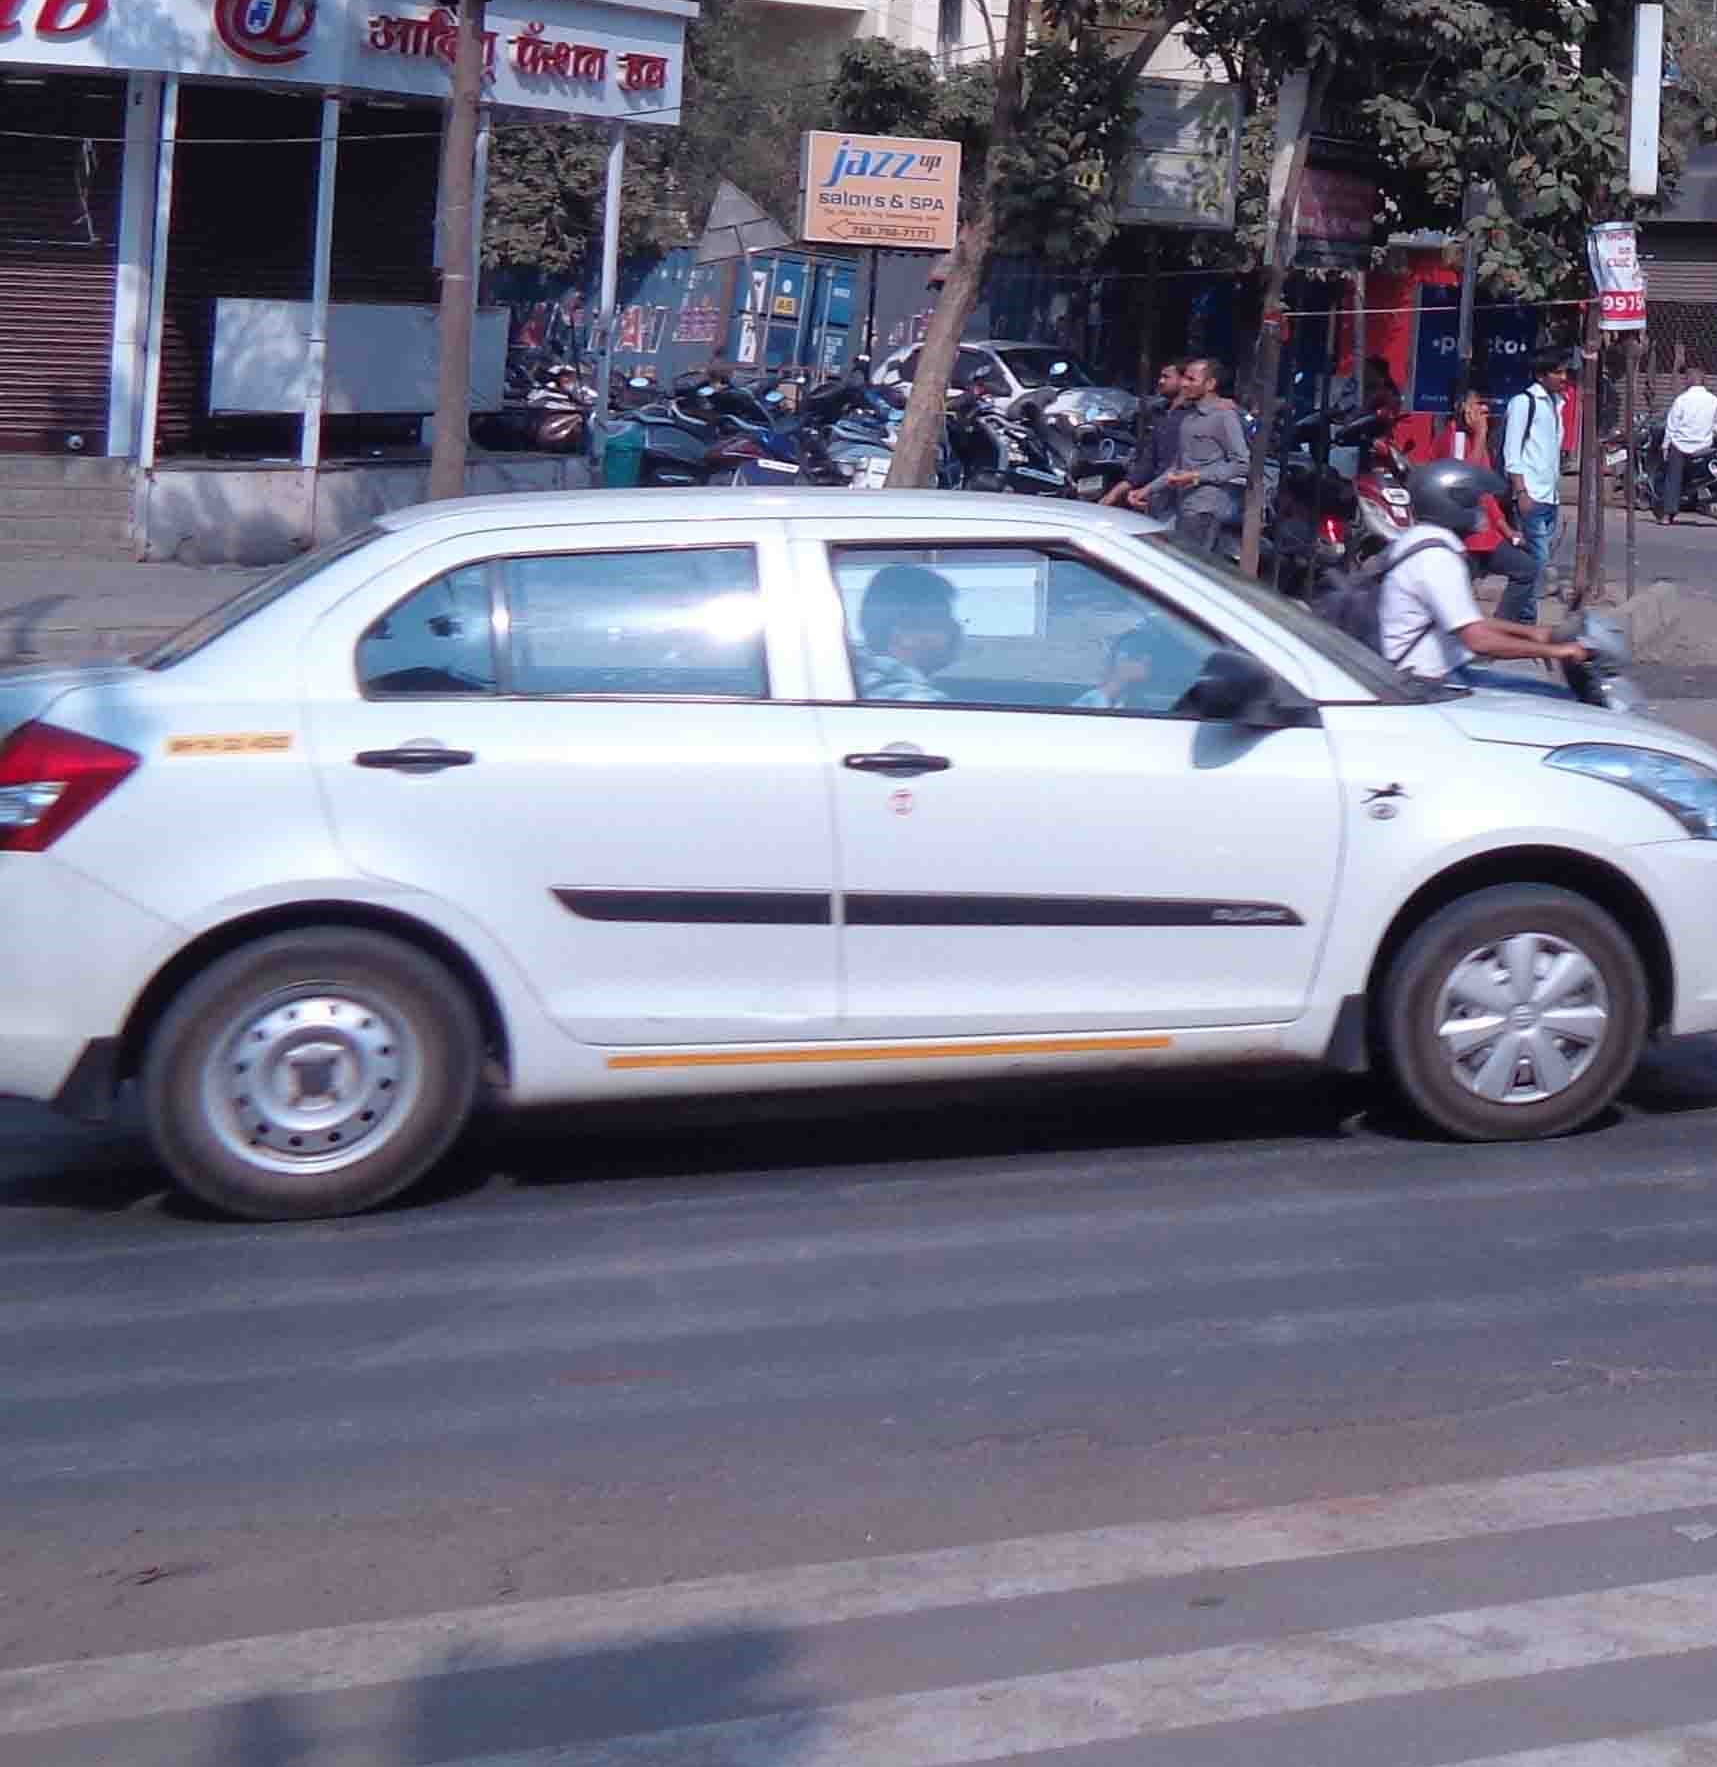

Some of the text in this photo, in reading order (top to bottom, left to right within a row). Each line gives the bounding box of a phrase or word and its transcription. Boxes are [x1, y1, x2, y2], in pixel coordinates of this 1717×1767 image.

[820, 138, 942, 188] jazz up
[890, 195, 904, 209] &
[910, 196, 944, 211] SPA
